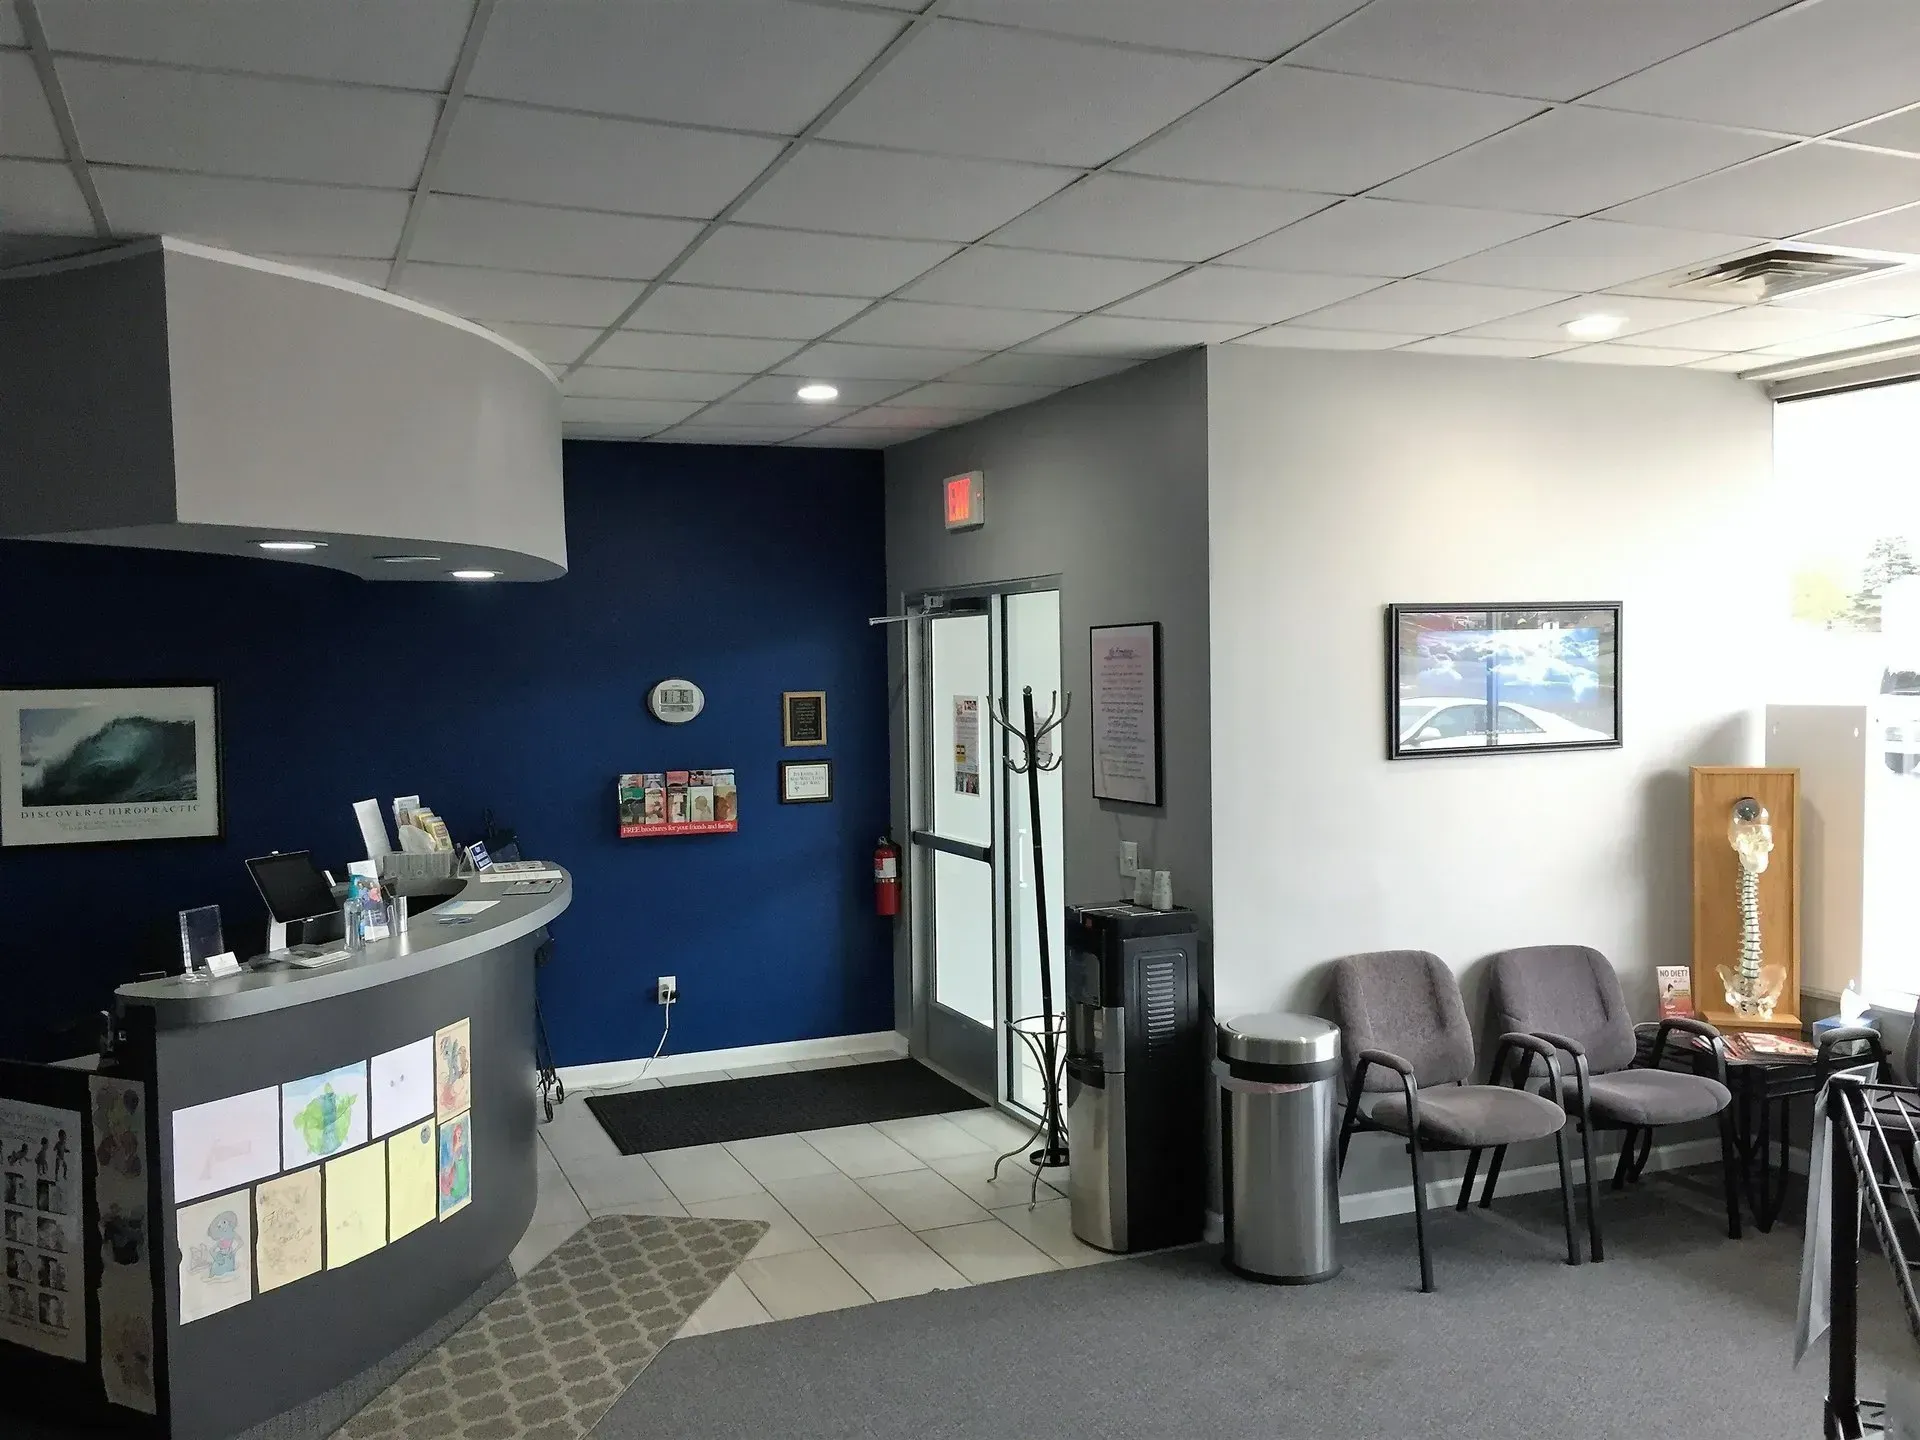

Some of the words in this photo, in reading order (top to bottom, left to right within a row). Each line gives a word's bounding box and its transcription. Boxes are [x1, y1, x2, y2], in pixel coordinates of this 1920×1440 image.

[20, 808, 92, 819] DISCOVER
[98, 804, 200, 816] CHIROPRACTIC
[1659, 969, 1670, 978] NO
[1670, 969, 1688, 978] DIET?
